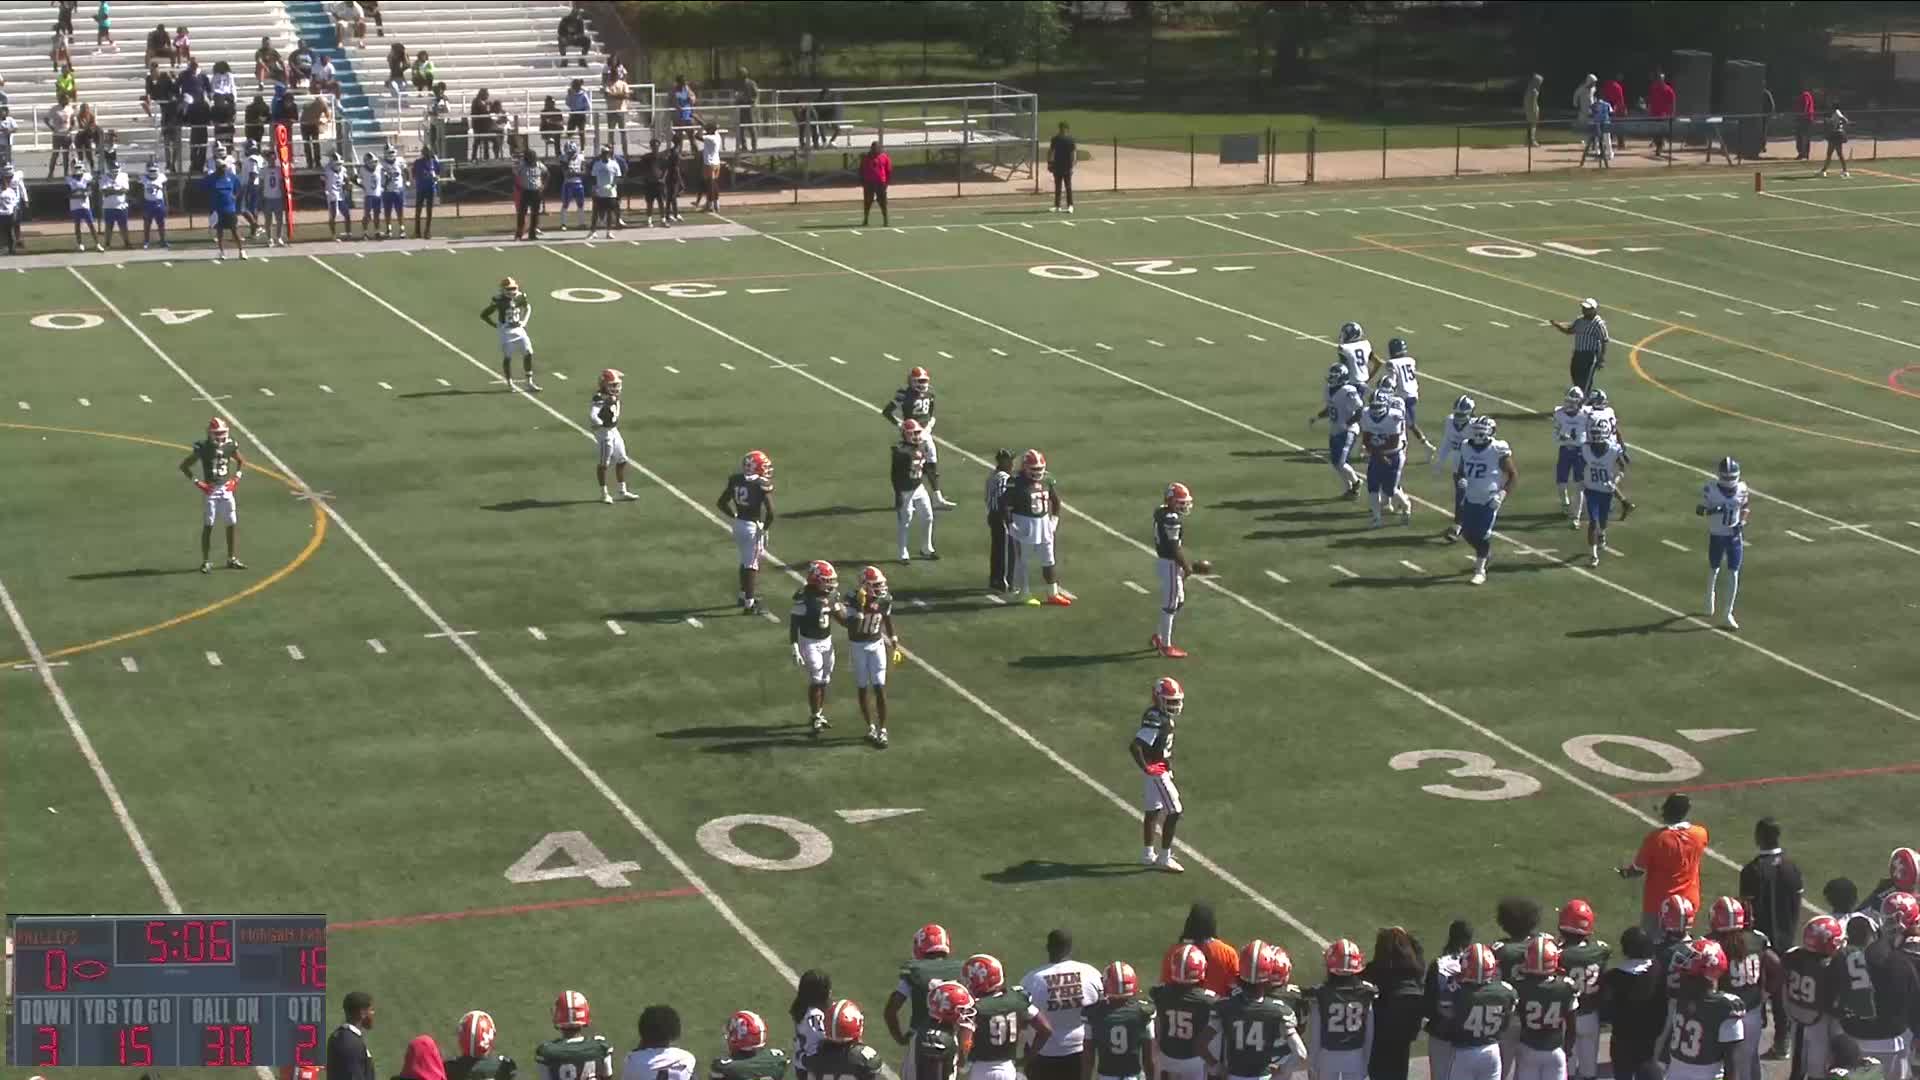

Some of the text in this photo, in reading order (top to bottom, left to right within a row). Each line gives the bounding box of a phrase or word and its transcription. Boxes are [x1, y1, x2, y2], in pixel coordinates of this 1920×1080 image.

[1354, 348, 1365, 367] 9
[1400, 363, 1414, 382] 15
[912, 398, 930, 415] 28
[1465, 461, 1488, 479] 72
[734, 485, 749, 505] 12
[1043, 971, 1081, 988] WIN
[1047, 984, 1083, 998] THE
[1788, 974, 1816, 1004] 29
[988, 1012, 1018, 1046] 91
[1165, 1009, 1194, 1041] 15
[1327, 1002, 1364, 1034] 28
[1463, 1004, 1503, 1039] 45
[1525, 1001, 1561, 1030] 24
[1110, 1025, 1129, 1055] 9
[1231, 1020, 1264, 1052] 14
